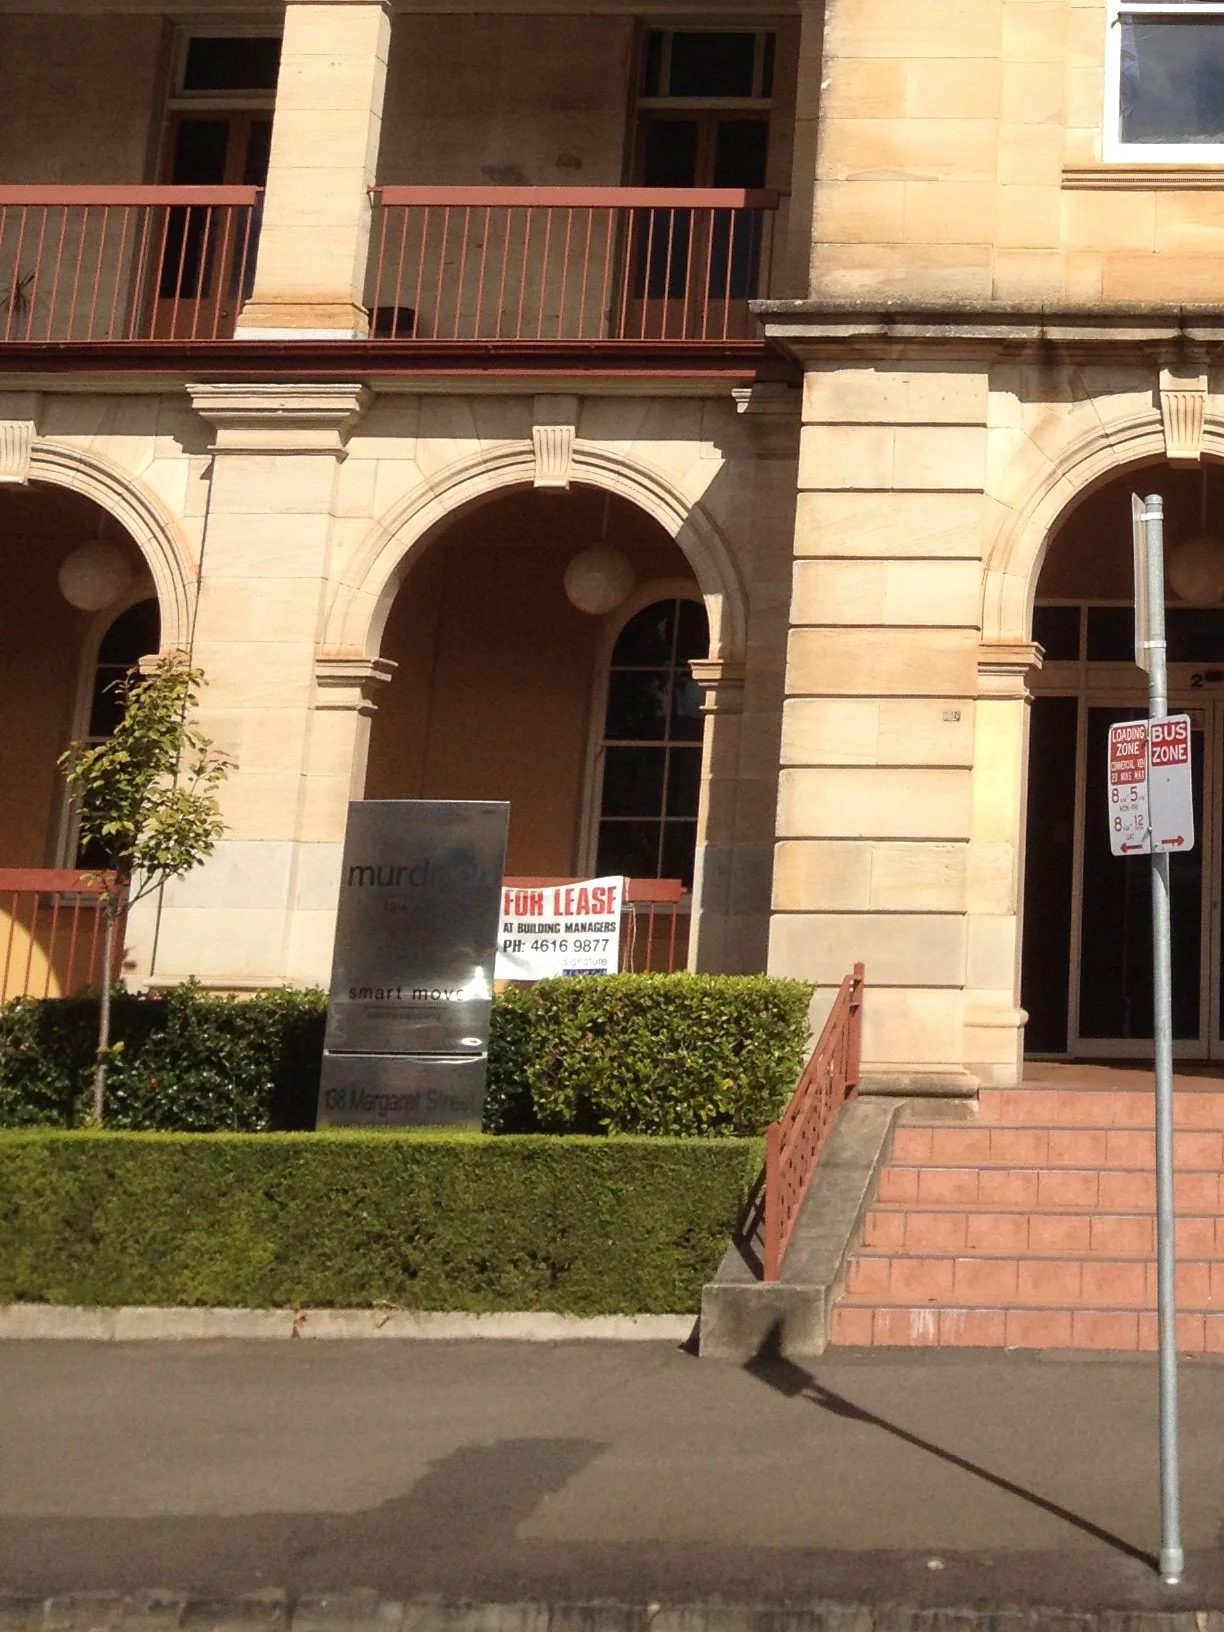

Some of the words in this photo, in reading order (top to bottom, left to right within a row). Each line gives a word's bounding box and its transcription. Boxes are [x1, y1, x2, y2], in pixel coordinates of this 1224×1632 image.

[1112, 727, 1145, 743] LOADING
[1152, 723, 1187, 743] BUS
[1116, 742, 1140, 757] ZONE
[1152, 744, 1187, 763] ZONE
[504, 889, 544, 916] FOR
[553, 885, 617, 916] LEASE
[503, 923, 513, 933] AT
[517, 922, 561, 934] BUILDING
[565, 921, 616, 933] MANAGERS
[530, 939, 568, 953] 4616
[573, 938, 609, 953] 9877
[349, 985, 402, 1001] smart
[350, 1088, 420, 1117] Margaret
